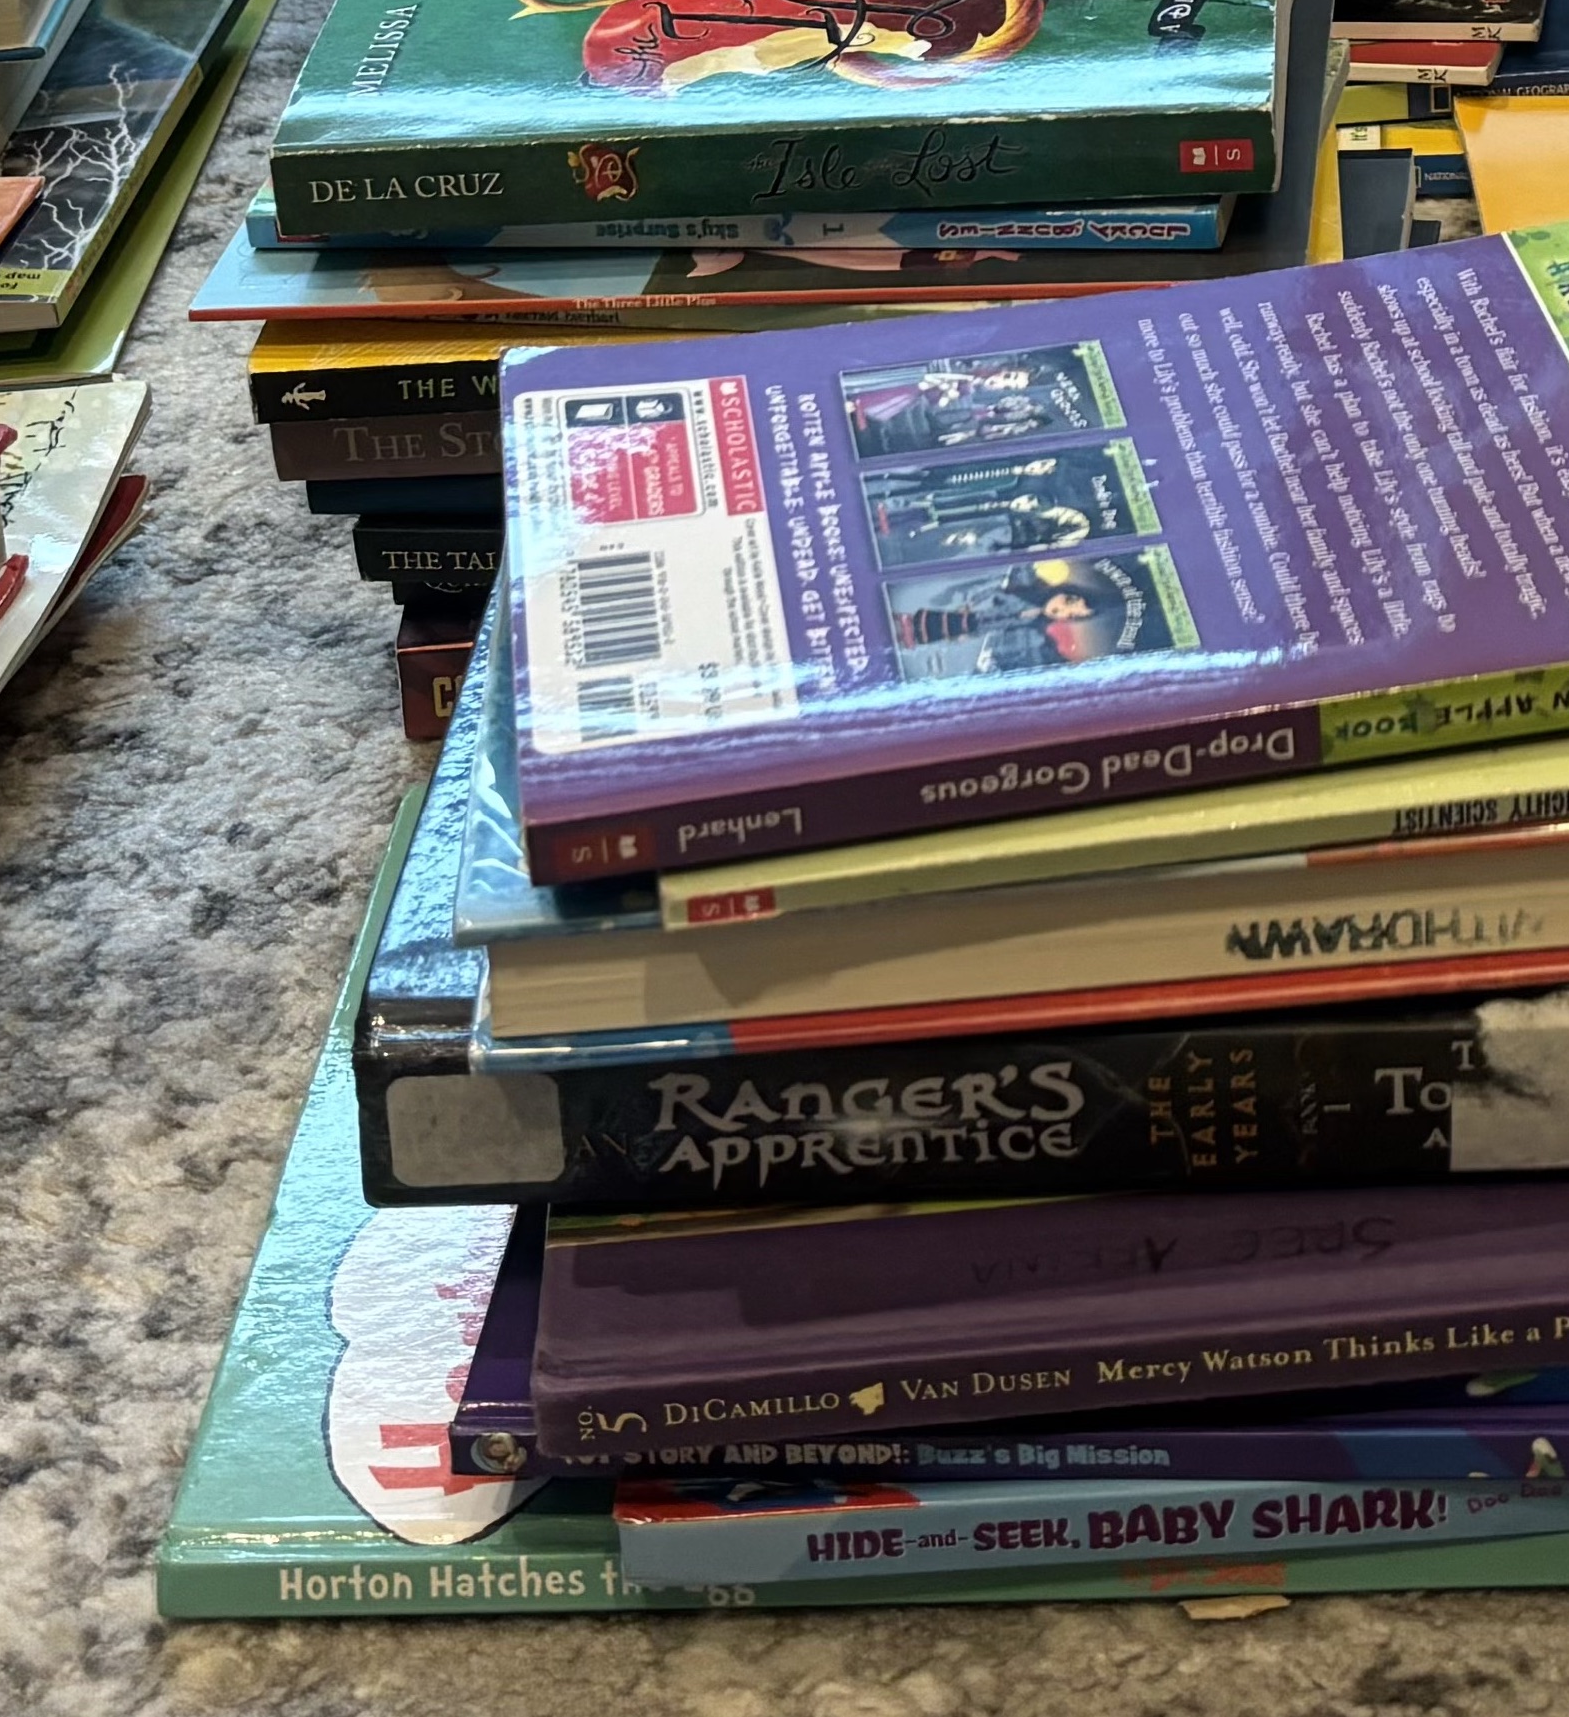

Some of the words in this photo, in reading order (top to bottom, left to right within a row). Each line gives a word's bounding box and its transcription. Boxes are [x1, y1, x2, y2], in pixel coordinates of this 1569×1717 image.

[348, 2, 419, 97] MELISSA
[309, 179, 357, 205] DE
[364, 177, 410, 204] LA
[414, 171, 505, 201] CRUZ
[398, 378, 456, 401] THE
[719, 395, 758, 512] SCHOLASTIC
[919, 762, 1090, 804] Gorgeous
[1099, 726, 1297, 796] Drop-Dead
[677, 807, 804, 853] Lenhard
[648, 1061, 1086, 1134] RANGER'S
[1097, 1351, 1194, 1384] Mercy
[1202, 1339, 1315, 1373] Watson
[1322, 1327, 1436, 1364] Thinks
[1446, 1320, 1518, 1351] Like
[1525, 1325, 1542, 1345] a
[1088, 1497, 1233, 1552] BABY
[1251, 1489, 1449, 1540] SHARK!
[278, 1564, 415, 1602] Horton
[428, 1563, 588, 1600] Hatches
